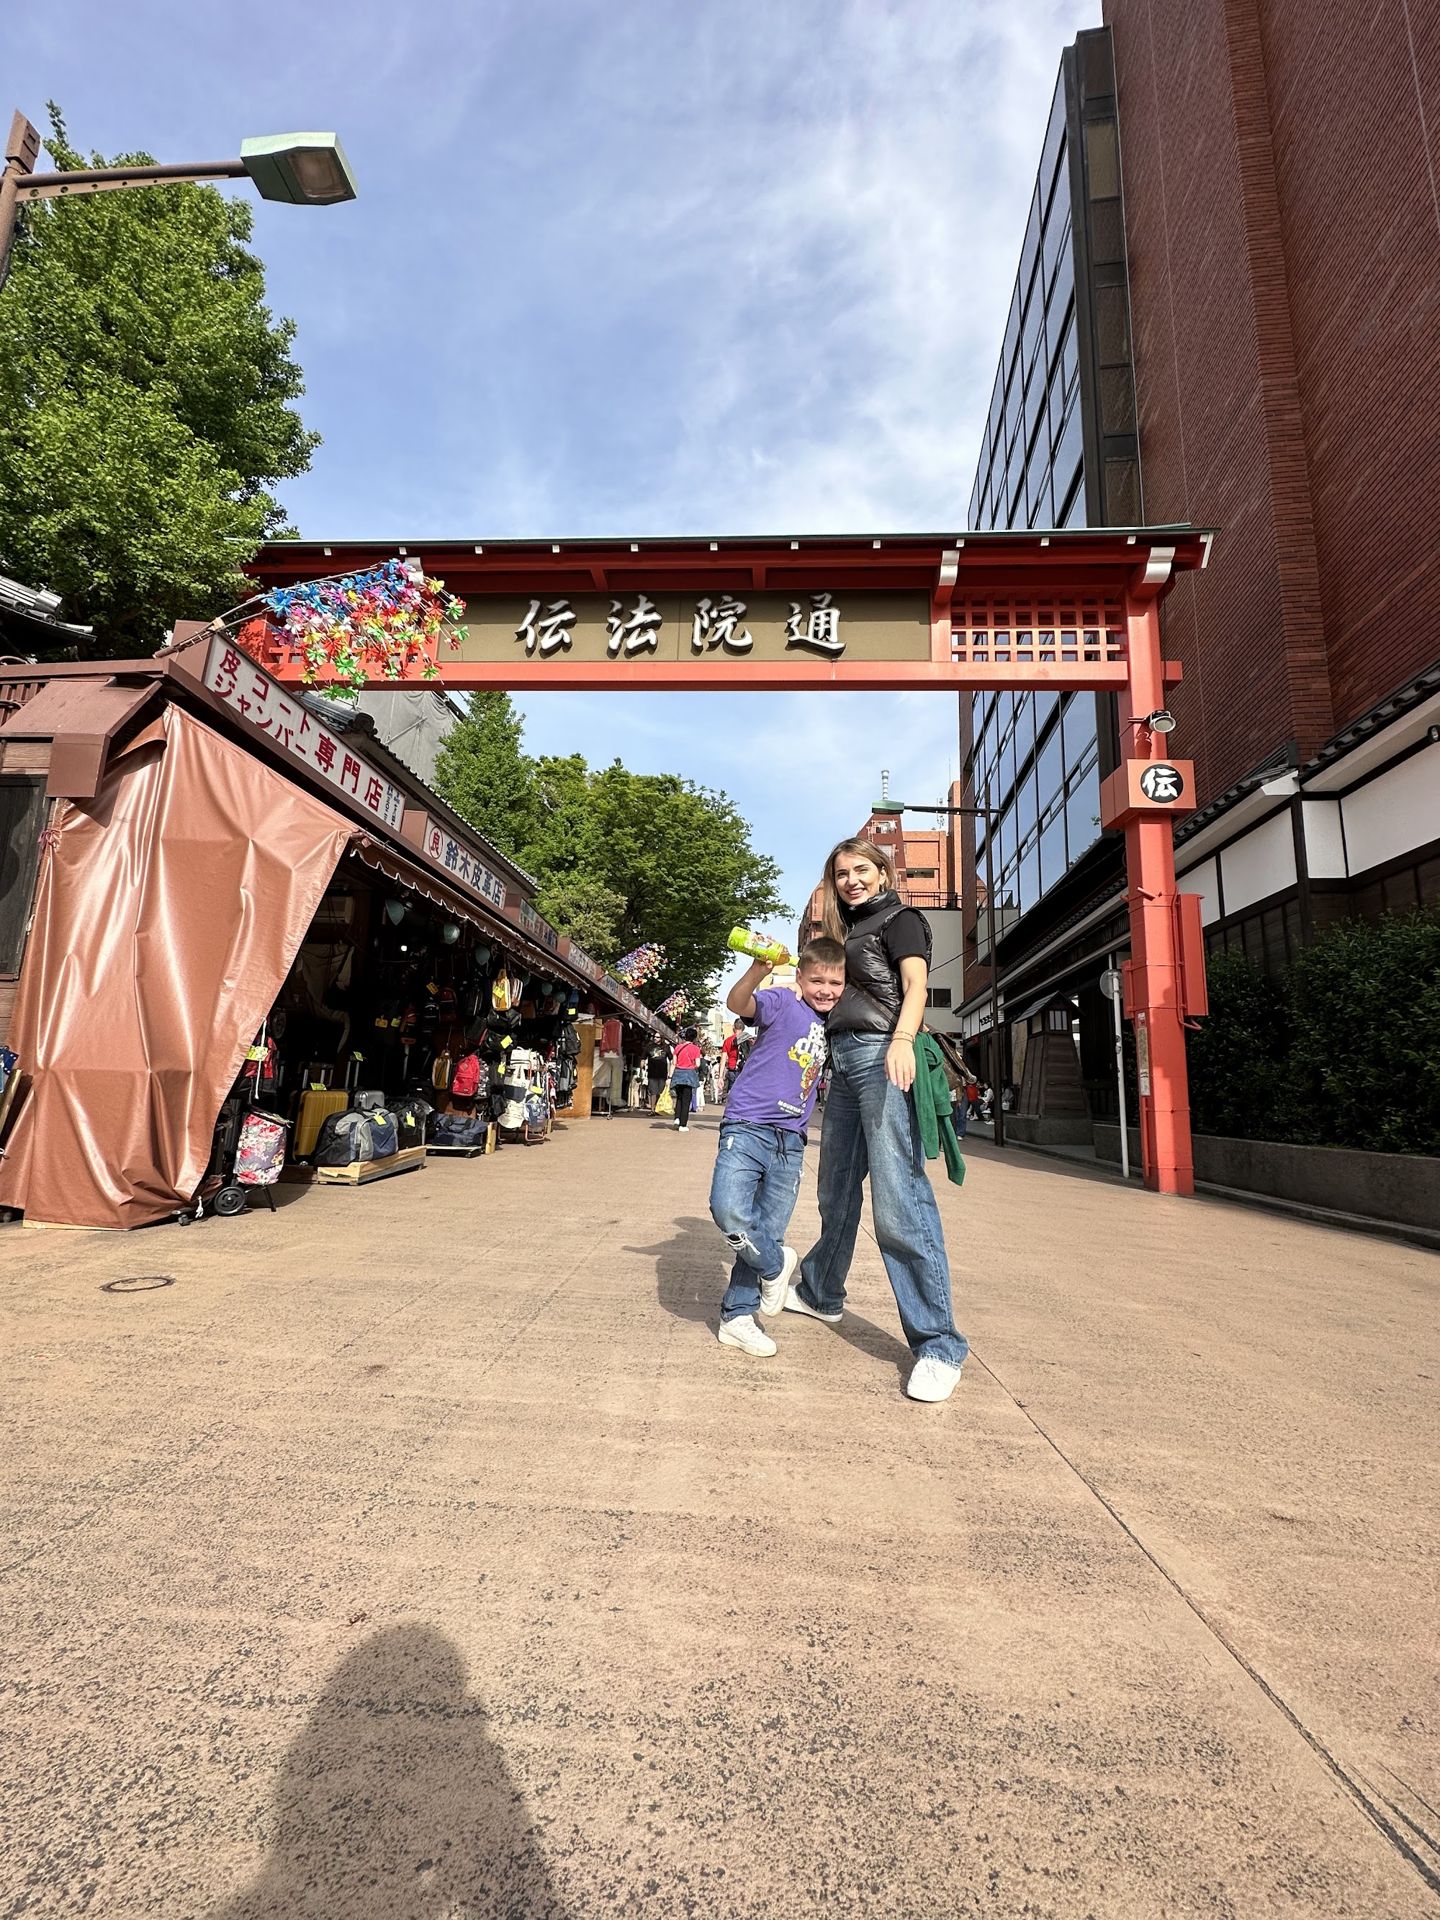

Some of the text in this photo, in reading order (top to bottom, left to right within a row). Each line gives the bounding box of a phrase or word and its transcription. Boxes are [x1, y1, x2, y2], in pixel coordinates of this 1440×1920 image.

[514, 592, 847, 658] 伝法院通
[314, 732, 384, 812] 専門店
[1141, 767, 1179, 798] 伝
